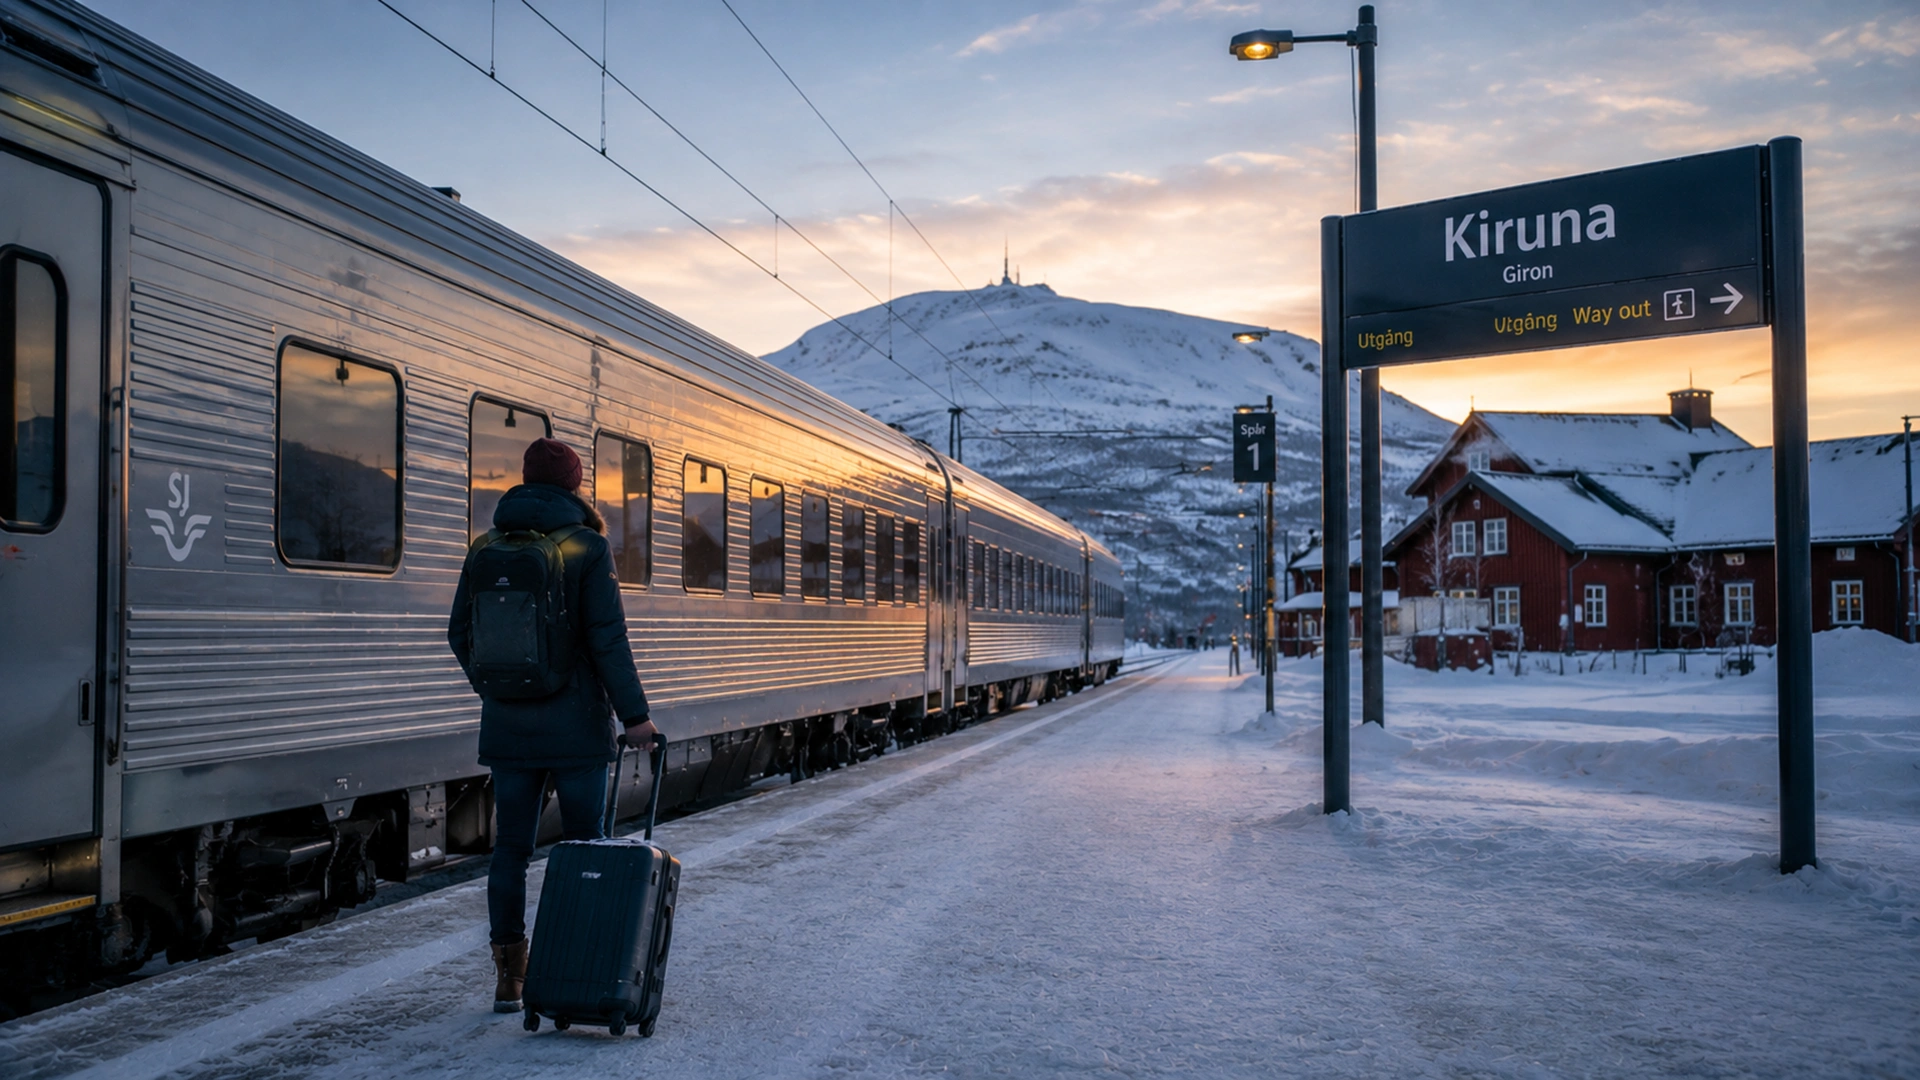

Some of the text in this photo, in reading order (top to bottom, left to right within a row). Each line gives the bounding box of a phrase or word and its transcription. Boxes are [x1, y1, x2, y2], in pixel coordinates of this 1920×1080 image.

[1445, 203, 1616, 262] Kiruna
[1502, 264, 1553, 284] Giron
[1572, 306, 1613, 326] Way
[1618, 300, 1652, 319] out
[1247, 442, 1259, 471] 1
[168, 471, 190, 517] SJ
